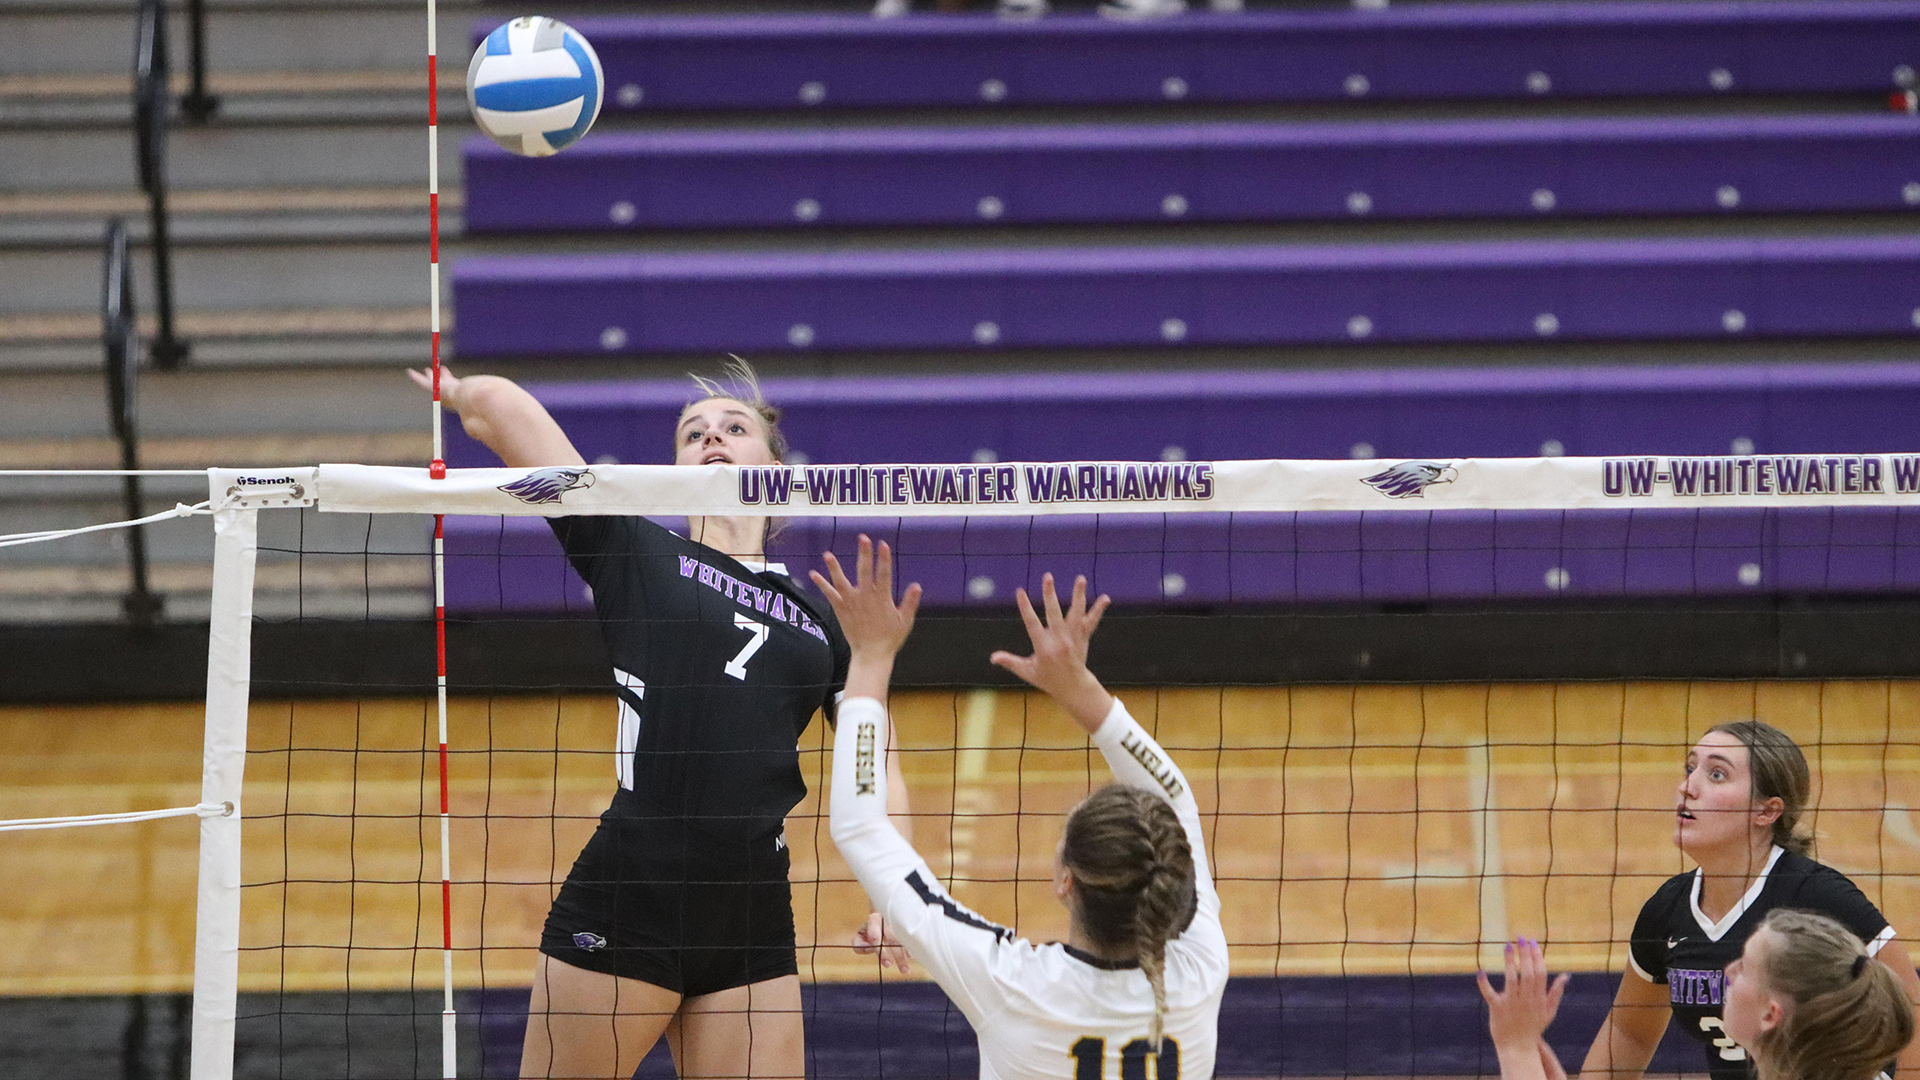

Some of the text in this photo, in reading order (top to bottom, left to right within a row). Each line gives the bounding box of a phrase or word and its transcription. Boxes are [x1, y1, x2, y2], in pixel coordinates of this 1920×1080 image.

[247, 477, 295, 485] Senoh
[739, 462, 1215, 505] UW-WHITEWATER WARHAWKS
[1602, 456, 1884, 496] UW-WHITEWATER
[724, 611, 770, 681] 7
[856, 722, 875, 796] MUSKIES
